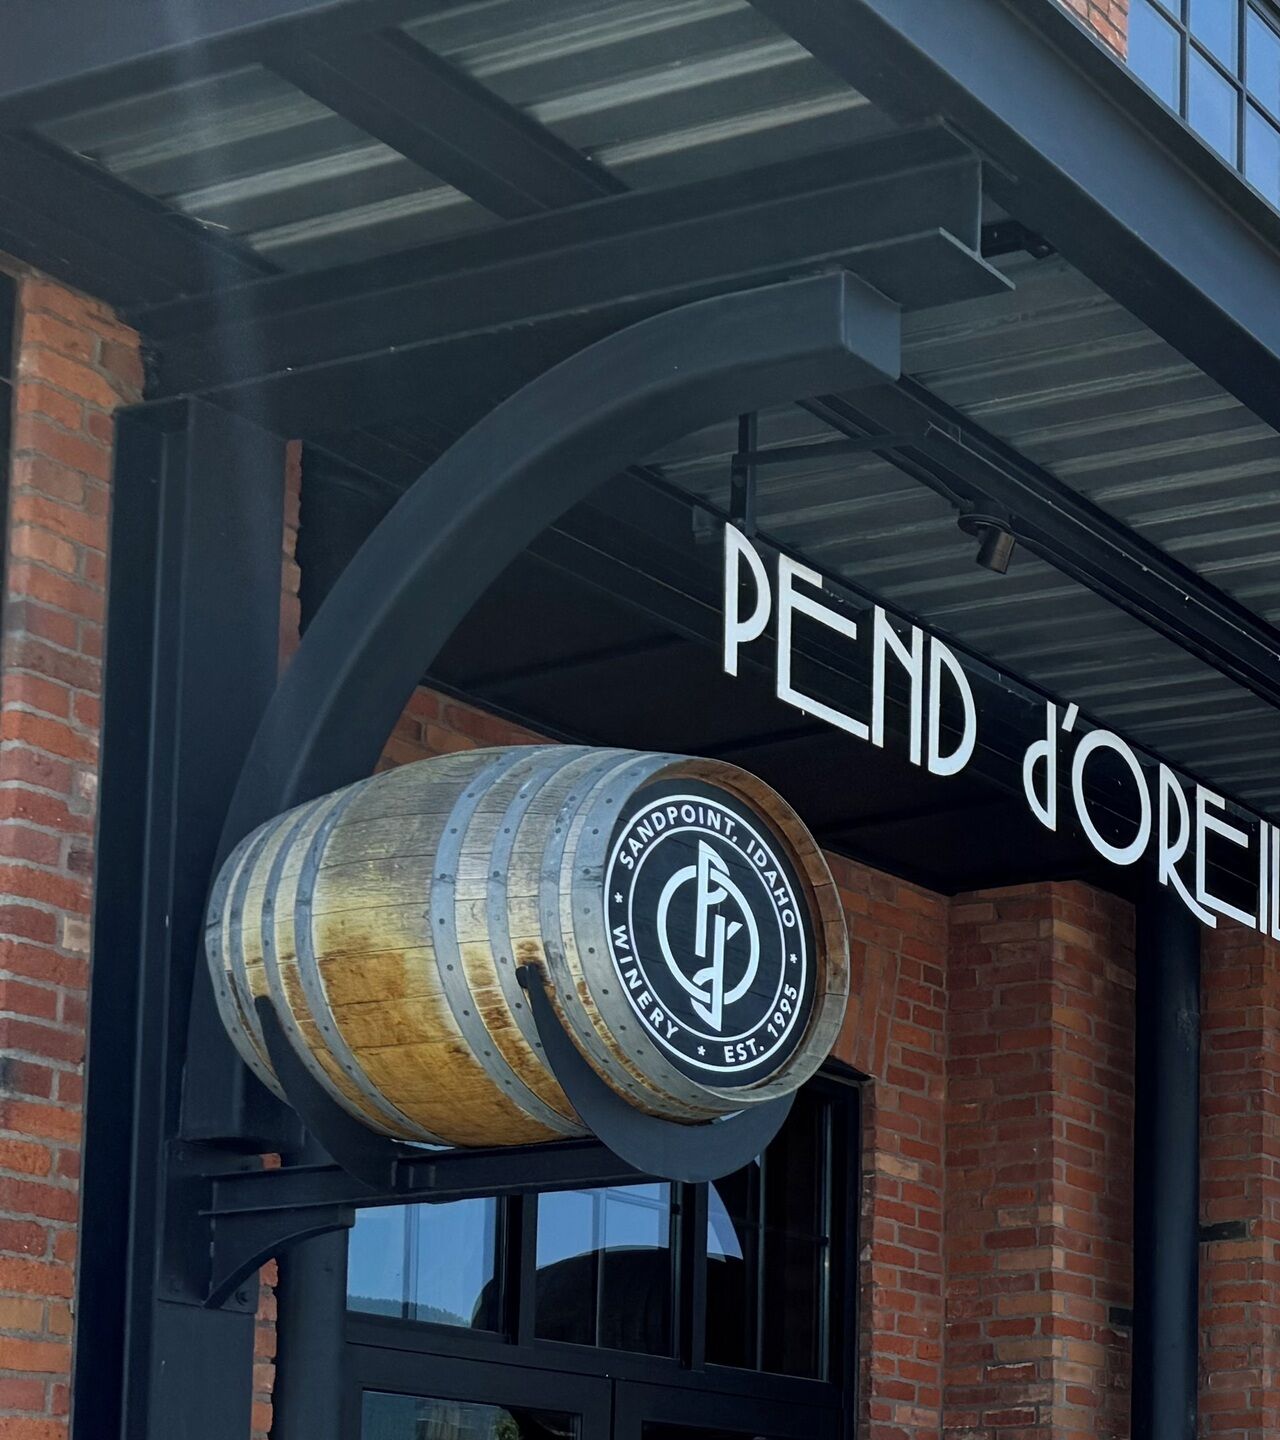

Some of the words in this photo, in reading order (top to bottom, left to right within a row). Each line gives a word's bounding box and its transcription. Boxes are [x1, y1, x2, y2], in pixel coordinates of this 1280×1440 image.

[725, 522, 977, 776] PEND
[619, 804, 738, 870] SANDPOINT,
[746, 839, 795, 928] IDAHO
[612, 924, 679, 1040] WINERY
[723, 1037, 765, 1063] EST.
[767, 983, 798, 1038] 1995
